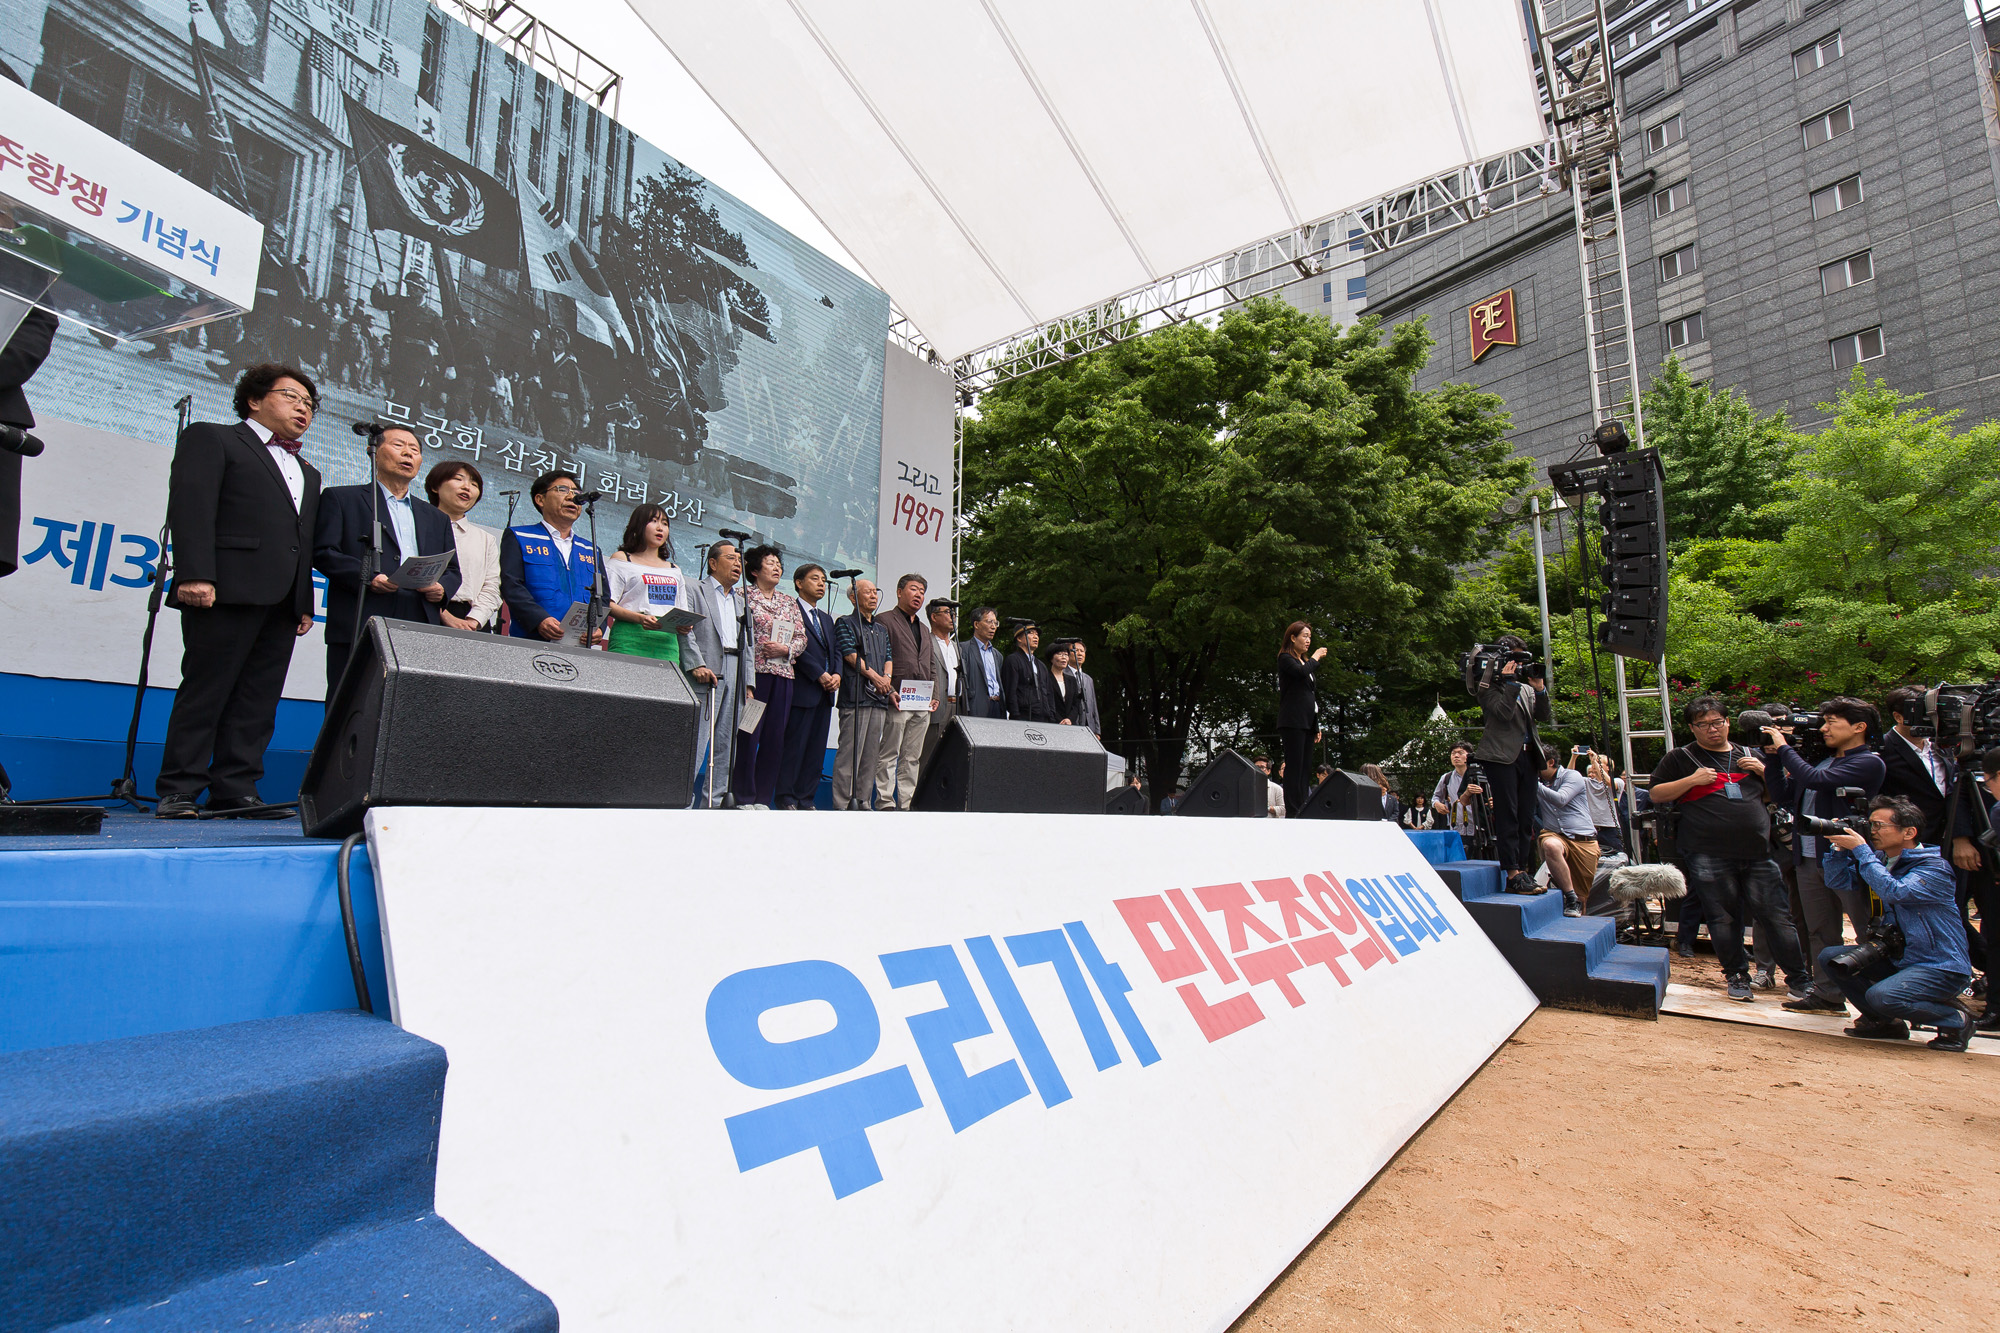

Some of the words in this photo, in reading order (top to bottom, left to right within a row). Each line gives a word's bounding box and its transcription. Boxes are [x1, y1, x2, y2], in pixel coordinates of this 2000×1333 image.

[116, 200, 221, 277] 기념식
[377, 400, 488, 461] 무궁화
[496, 439, 587, 487] 삼천리
[597, 469, 648, 504] 화려
[657, 490, 706, 526] 강산
[898, 461, 942, 495] 그리고
[893, 493, 944, 542] 1987
[22, 516, 173, 593] 제3
[645, 574, 677, 585] FEMINISM
[648, 584, 676, 593] PERFECTS
[705, 920, 1162, 1200] 우리가
[1113, 870, 1457, 1043] 민주주의입니다
